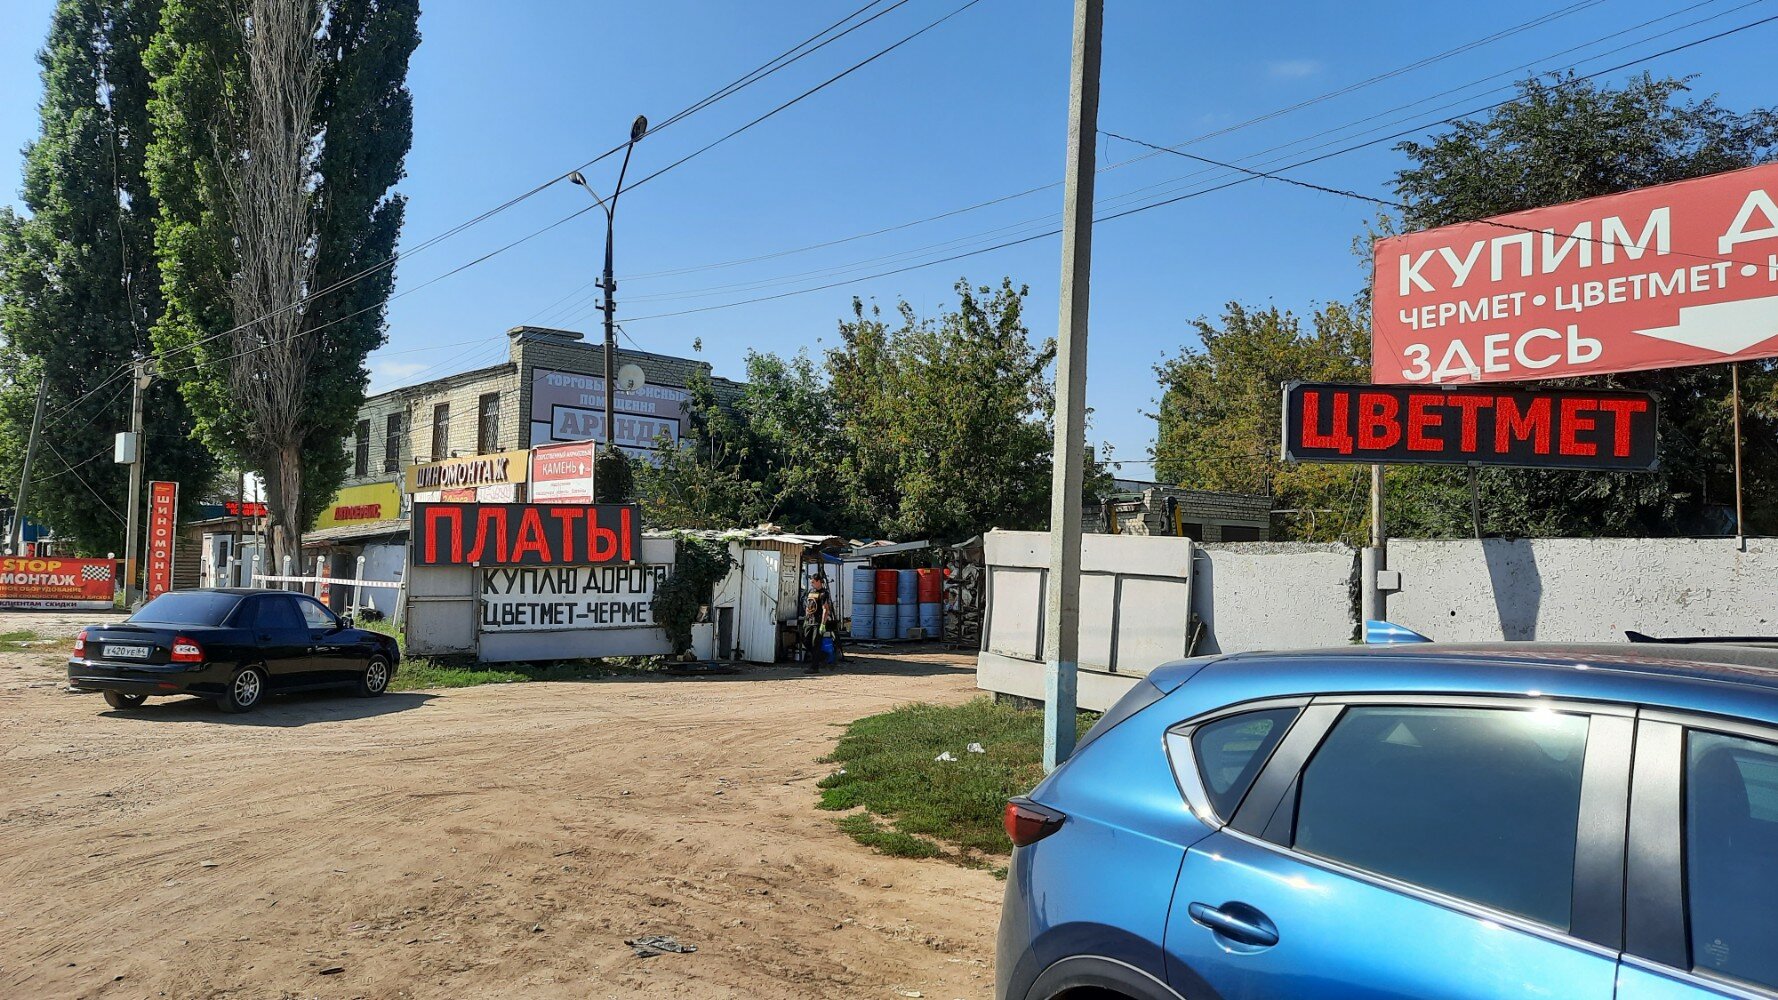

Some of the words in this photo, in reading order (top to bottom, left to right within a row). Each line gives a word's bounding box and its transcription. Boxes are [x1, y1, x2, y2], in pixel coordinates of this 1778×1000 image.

[1399, 207, 1670, 297] КУПИМ
[1399, 291, 1526, 330] ЧЕРМЕТ
[1555, 261, 1733, 312] ЦВЕТМЕТ
[1403, 324, 1602, 384] ЗДЕСЬ
[546, 374, 609, 391] ТОРГОВЫ
[580, 394, 656, 413] ПОМЩЕНИЯ
[1302, 392, 1648, 458] ЦВЕТМЕТ
[416, 457, 510, 488] ШИНОМОНТАЖ
[542, 460, 577, 476] КАМЕНЬ
[154, 495, 170, 600] ШИНОМОНТА
[425, 507, 631, 563] ПЛАТЫ
[3, 559, 61, 572] STOP
[482, 567, 578, 595] КУПЛЮ
